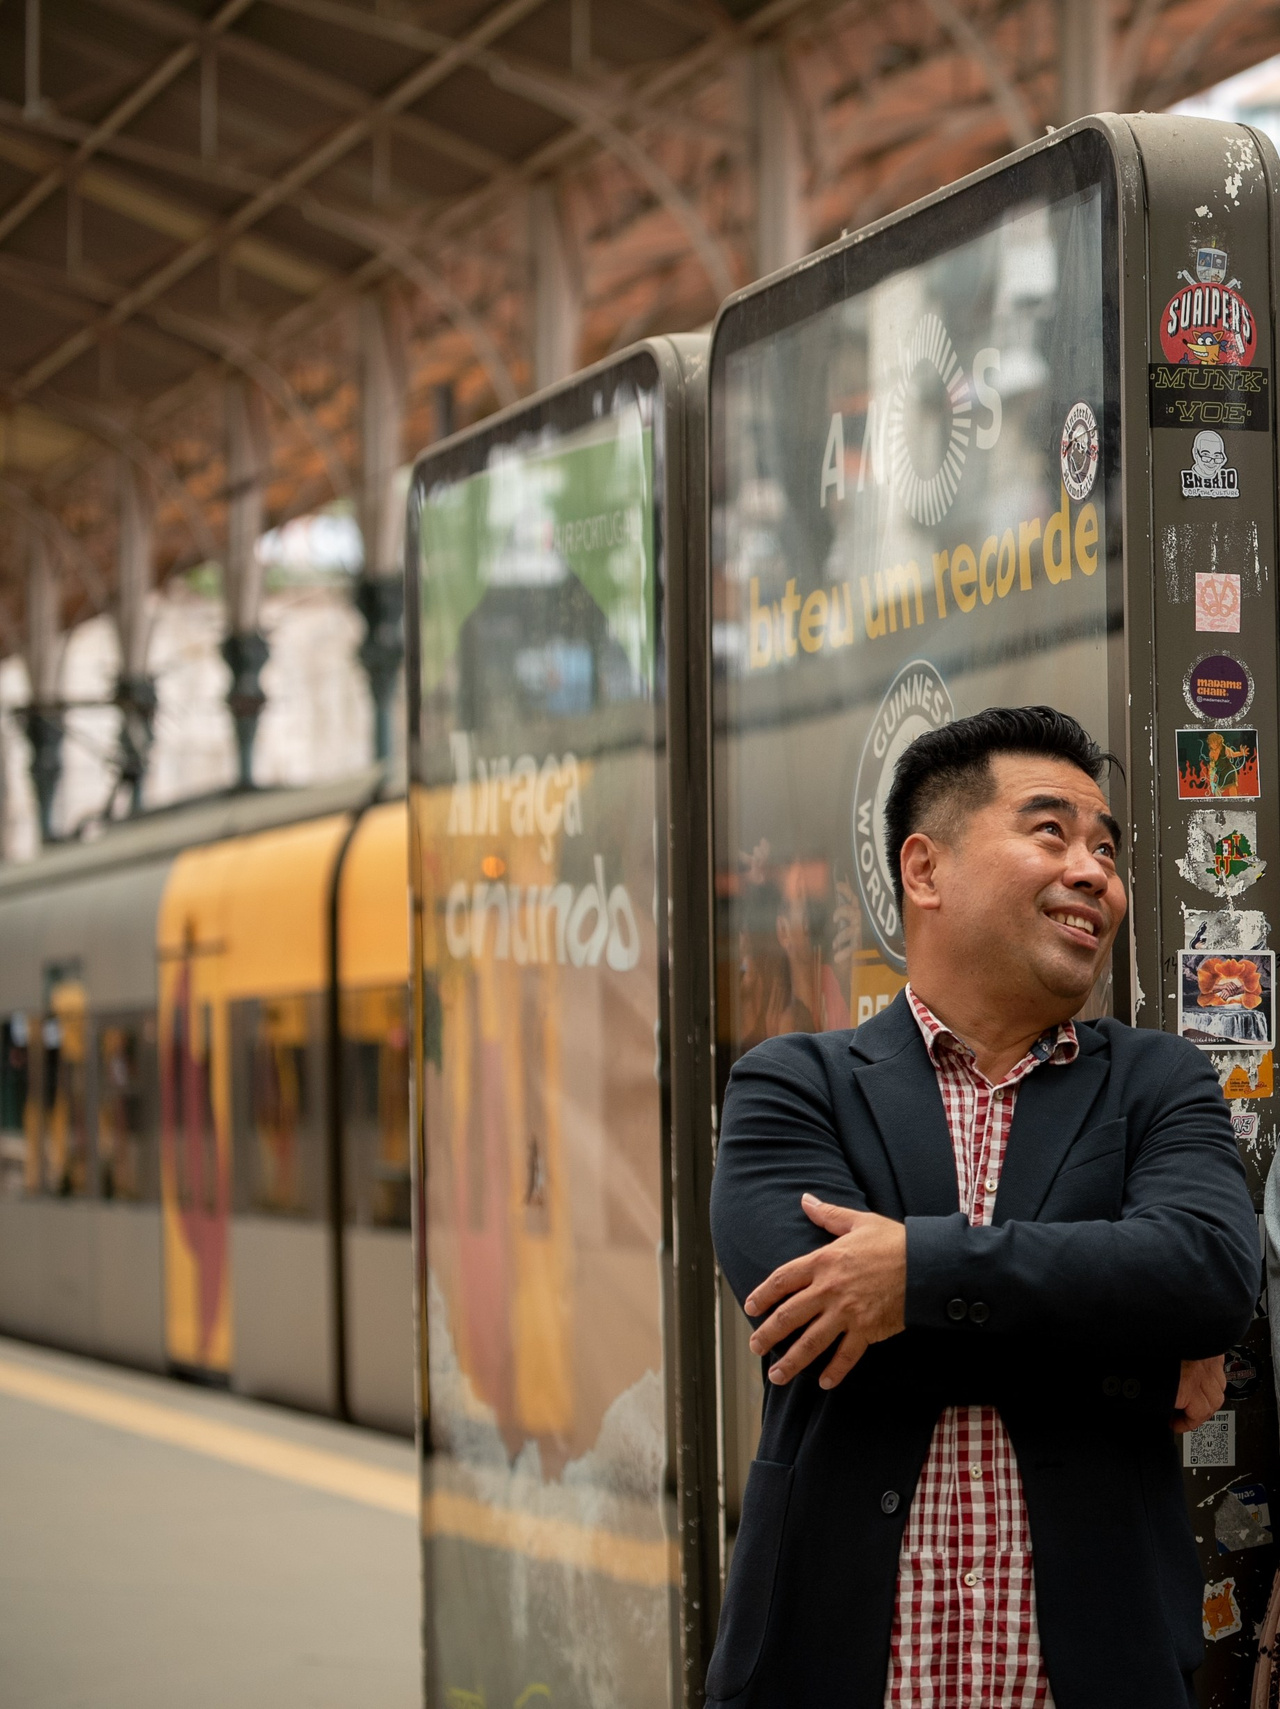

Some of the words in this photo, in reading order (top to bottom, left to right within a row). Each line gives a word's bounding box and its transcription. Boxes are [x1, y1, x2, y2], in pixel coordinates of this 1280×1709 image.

[820, 412, 845, 508] A
[860, 560, 925, 640] um
[932, 482, 1099, 620] recorde
[857, 799, 899, 937] WORLD
